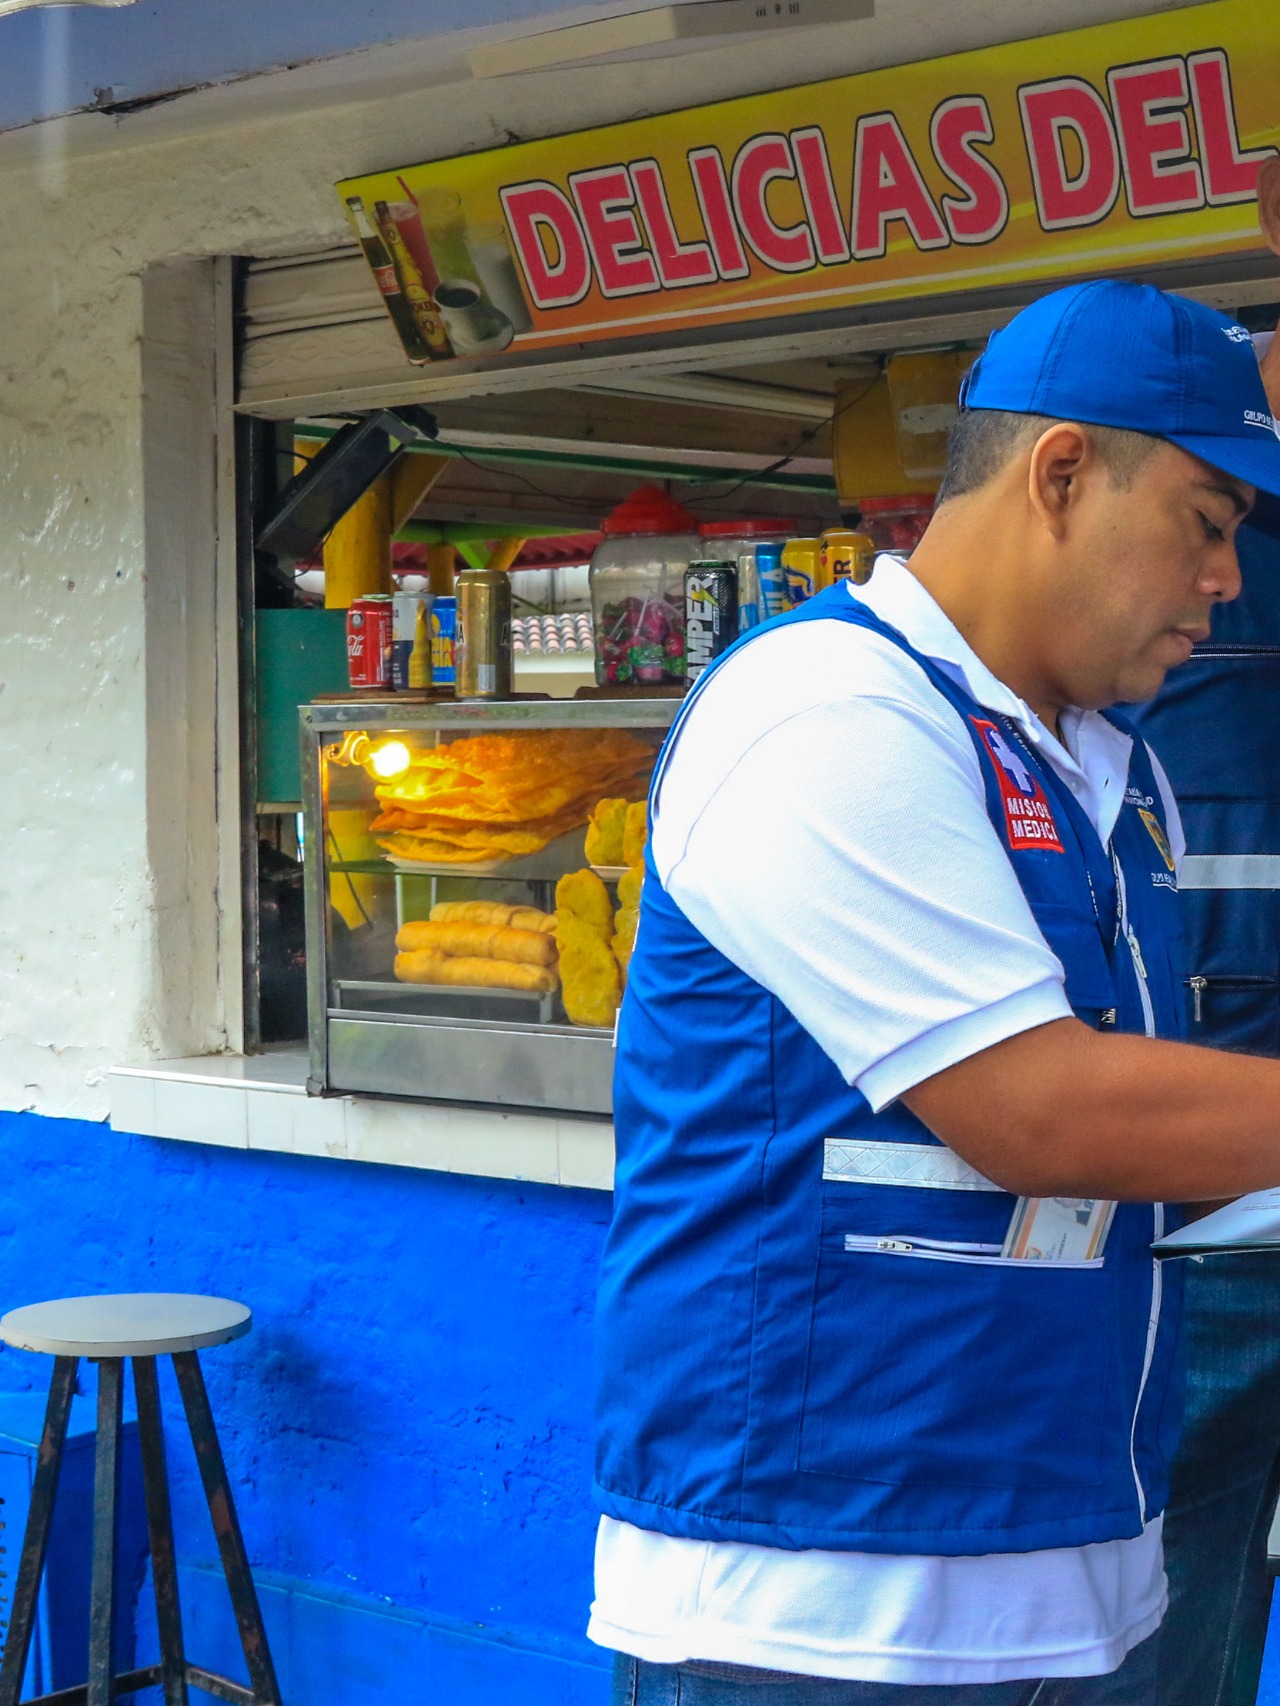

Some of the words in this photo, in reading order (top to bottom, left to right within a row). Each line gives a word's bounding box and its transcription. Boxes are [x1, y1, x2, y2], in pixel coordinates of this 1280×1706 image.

[499, 95, 1009, 310] DELICIAS
[1017, 47, 1280, 233] DEL
[1243, 409, 1266, 424] GRUPO
[1006, 797, 1052, 820] MISION
